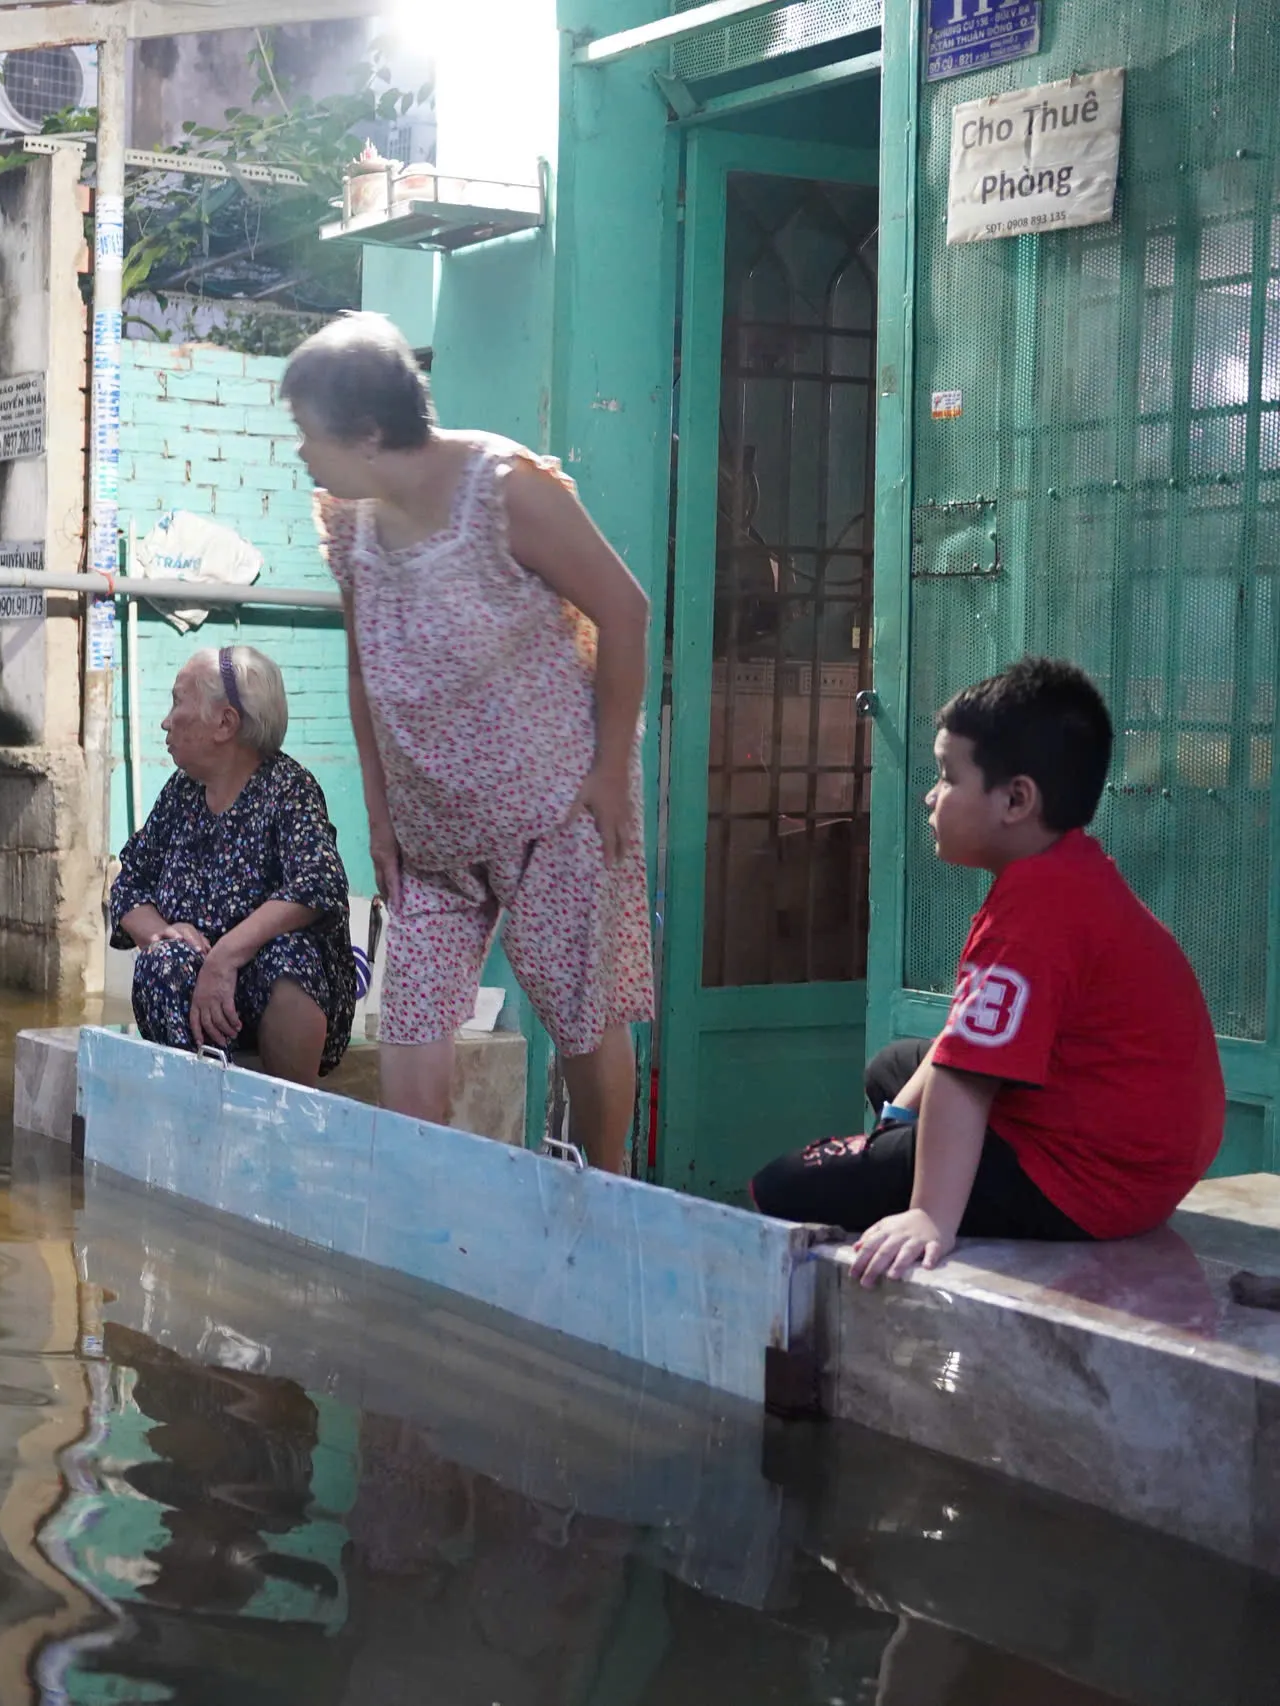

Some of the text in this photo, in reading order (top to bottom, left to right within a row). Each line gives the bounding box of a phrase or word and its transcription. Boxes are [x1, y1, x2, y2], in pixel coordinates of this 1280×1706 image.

[962, 90, 1099, 150] Cho Thuê
[981, 165, 1074, 205] Phòng
[1007, 217, 1029, 231] 0908
[1031, 213, 1047, 226] 893
[1050, 210, 1066, 222] 135
